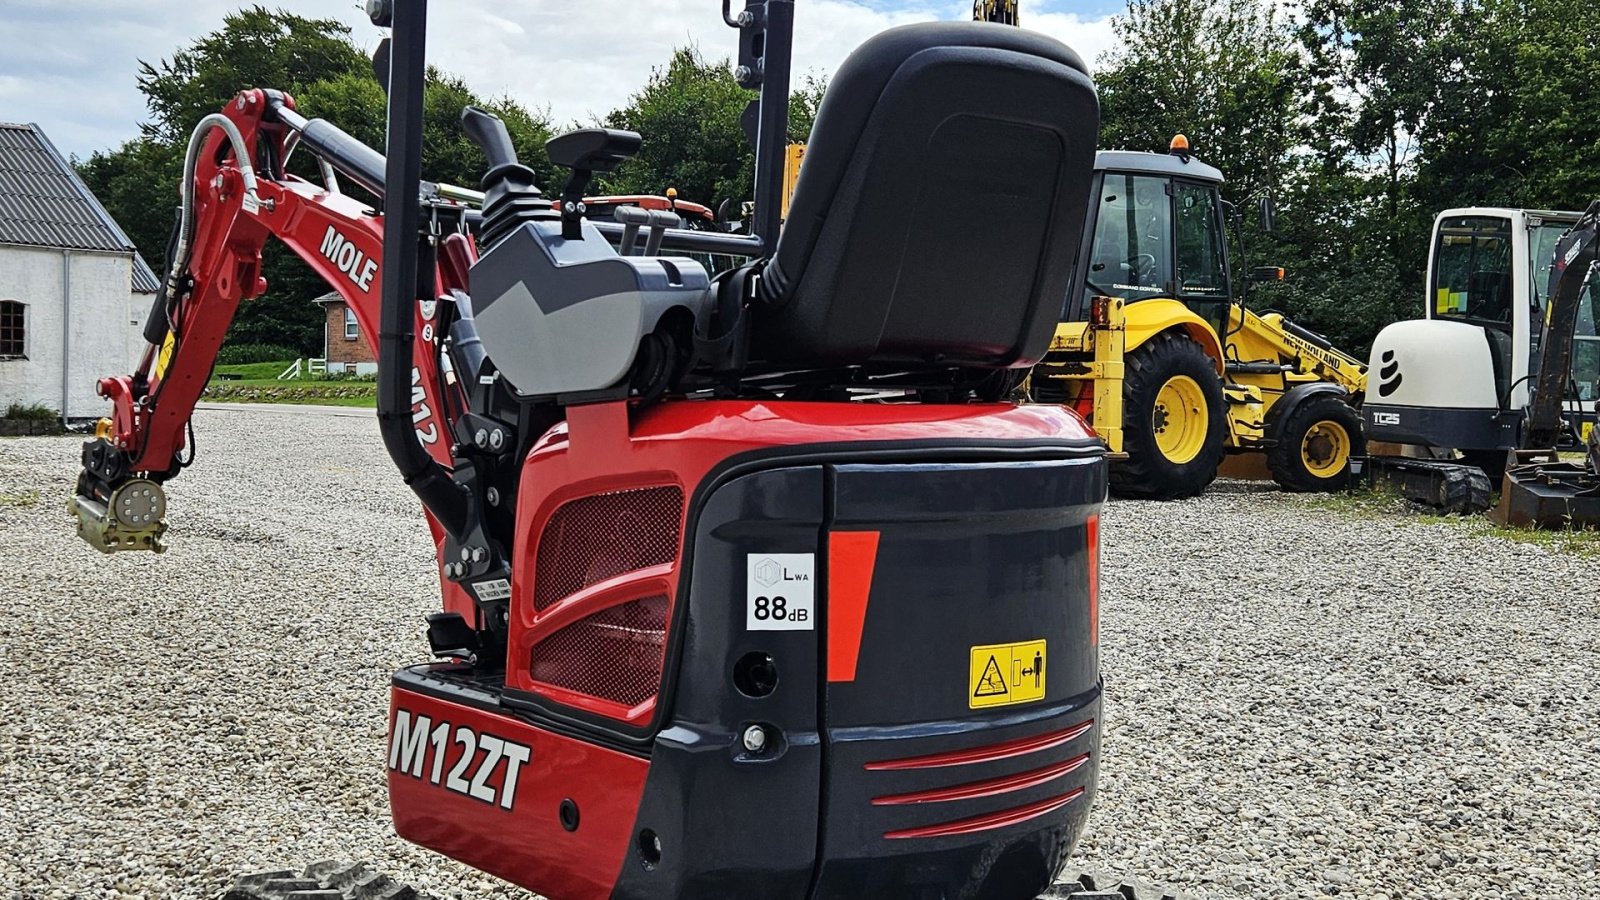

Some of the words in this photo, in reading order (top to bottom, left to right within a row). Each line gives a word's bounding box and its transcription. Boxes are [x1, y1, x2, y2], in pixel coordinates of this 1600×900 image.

[319, 224, 379, 293] MOLE
[1283, 333, 1303, 351] NEW
[1373, 412, 1400, 425] TC25
[388, 709, 531, 810] M12ZT
